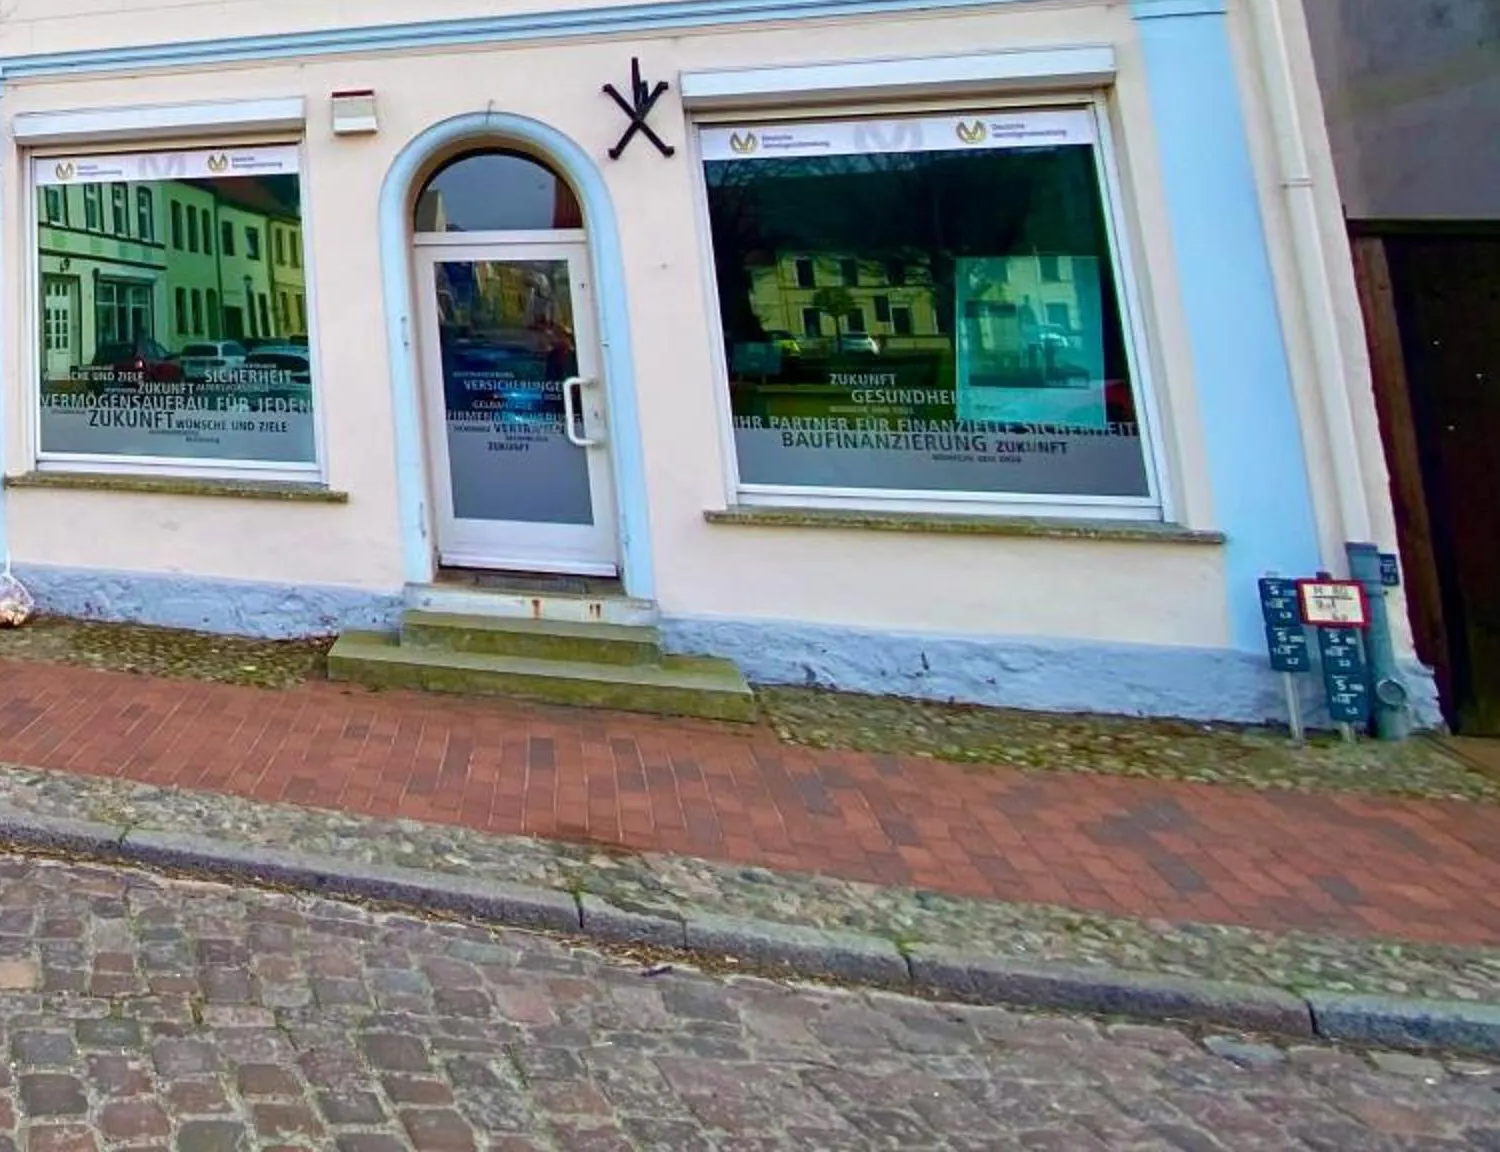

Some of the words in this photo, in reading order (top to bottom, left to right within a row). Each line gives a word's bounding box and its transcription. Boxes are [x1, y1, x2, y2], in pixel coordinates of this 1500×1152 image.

[203, 368, 293, 385] SICHERHEIT
[828, 373, 897, 387] ZUKUNFT
[137, 382, 195, 395] ZUKUNFT
[851, 388, 958, 405] GESUNDHEI
[217, 393, 249, 413] FÜR
[88, 409, 176, 429] ZUKUNFT
[231, 420, 256, 431] UND
[258, 421, 288, 433] ZIELE
[769, 415, 849, 432] PARTNER
[856, 415, 890, 433] FÜR
[781, 431, 988, 452] BAUFINANZIERUNG
[995, 440, 1068, 454] ZUKUNFT
